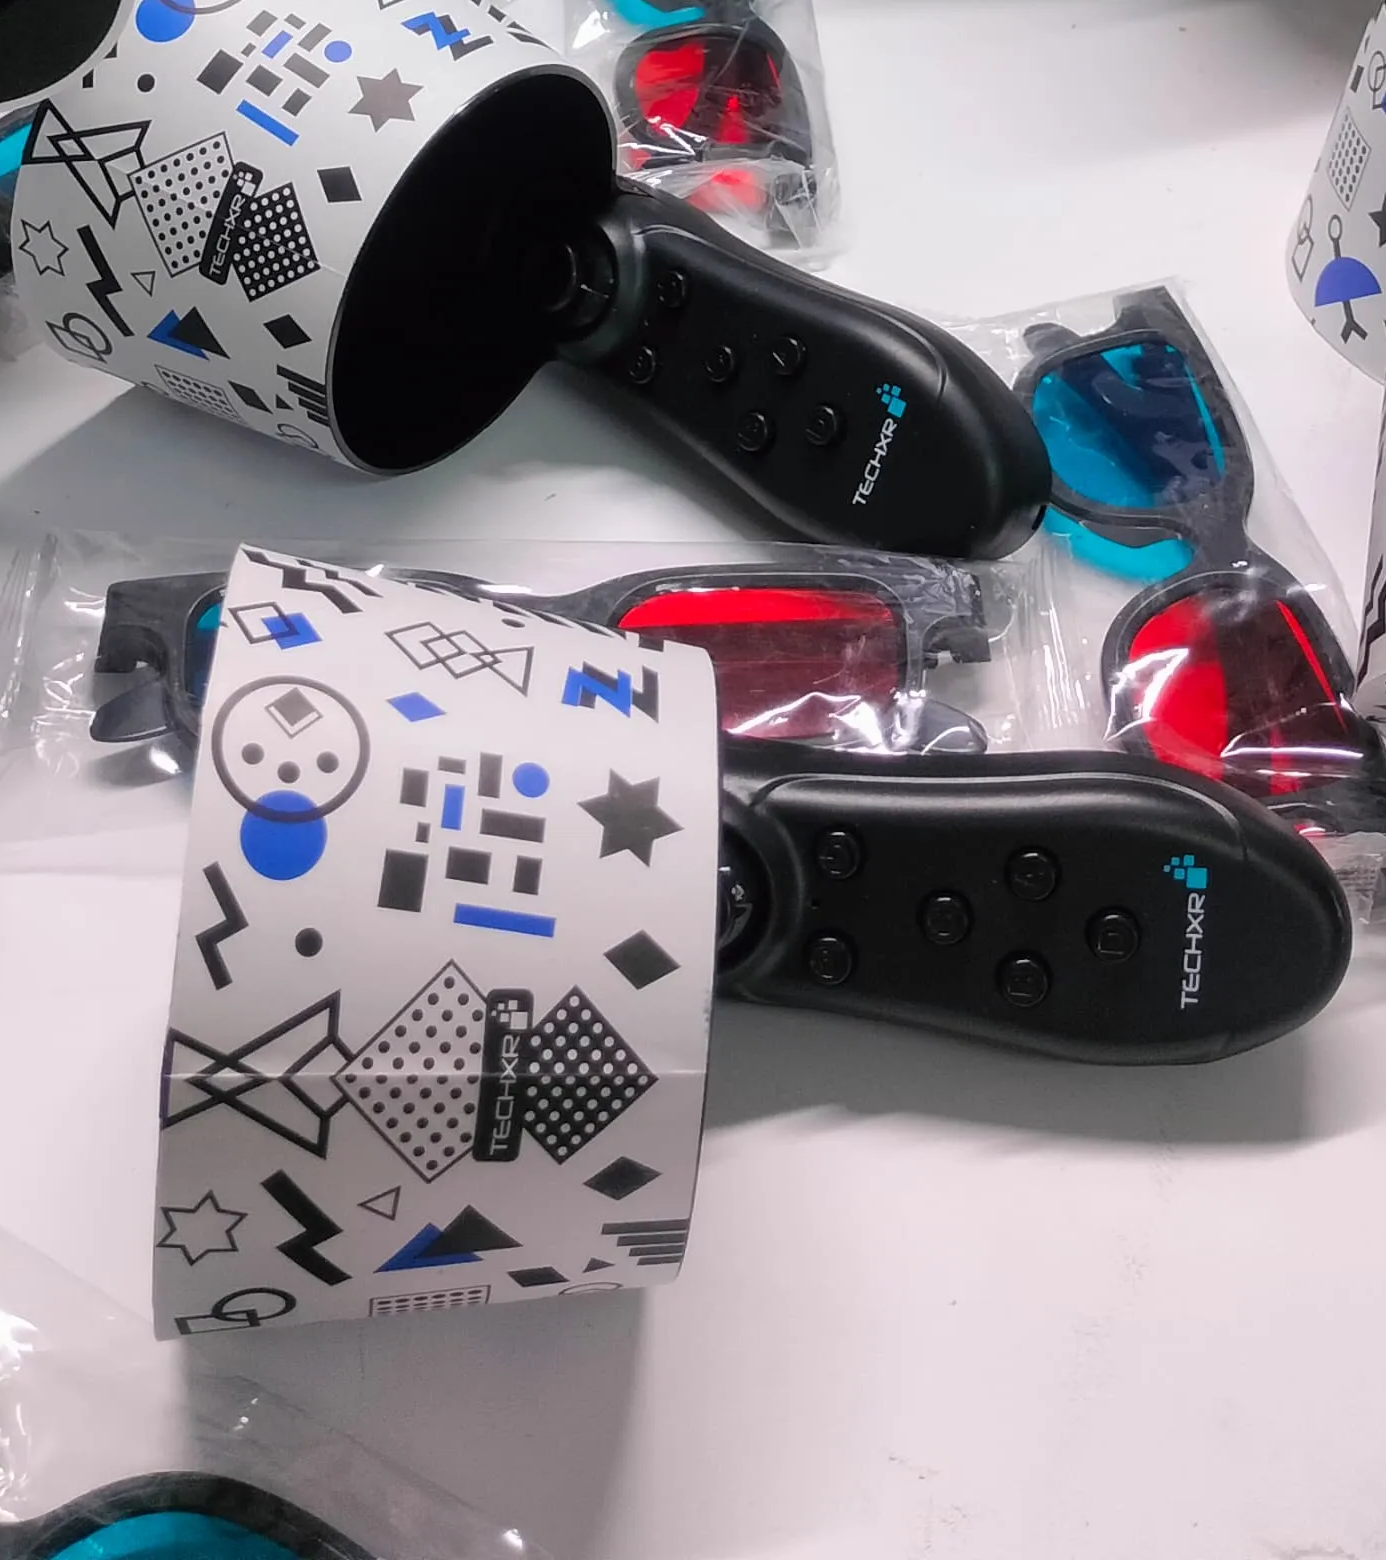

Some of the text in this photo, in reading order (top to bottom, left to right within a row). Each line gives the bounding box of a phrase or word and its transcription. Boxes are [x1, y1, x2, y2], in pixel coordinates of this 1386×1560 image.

[208, 193, 246, 276] TECHXR
[851, 417, 898, 505] TECHXR
[1179, 891, 1206, 1010] TECHXR
[489, 1033, 521, 1157] TECHXR
